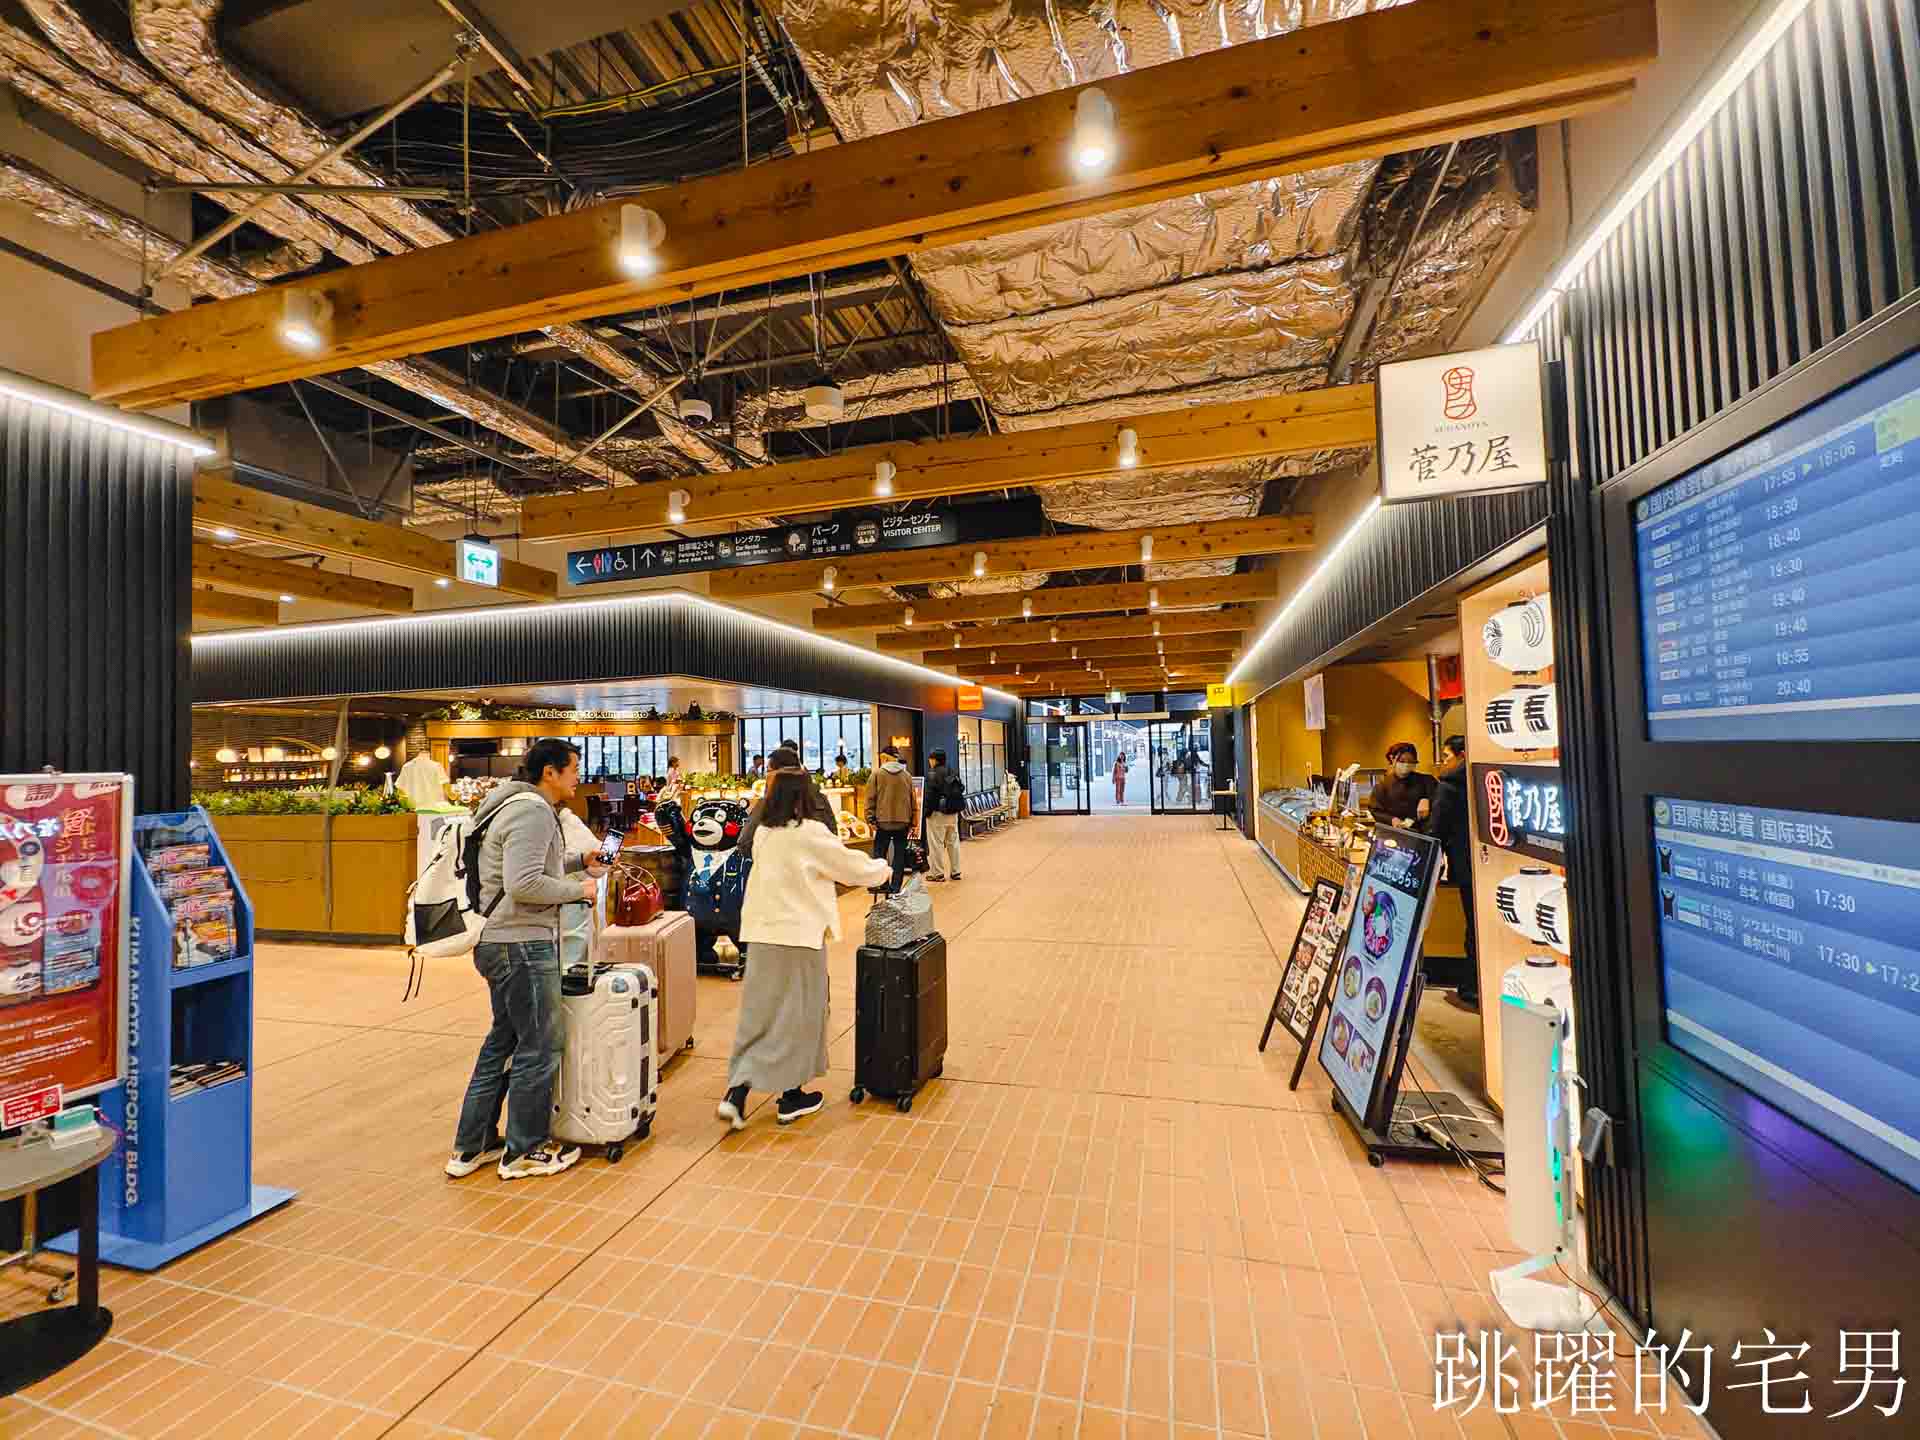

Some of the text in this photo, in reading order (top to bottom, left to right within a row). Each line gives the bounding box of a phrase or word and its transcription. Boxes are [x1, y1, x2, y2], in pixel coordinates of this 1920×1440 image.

[1409, 435, 1519, 483] 菅乃屋
[812, 524, 840, 536] パーク
[882, 513, 940, 528] ビジターセンター
[883, 524, 941, 537] VISITOR CENTER
[735, 535, 768, 544] レンタカー
[1777, 680, 1811, 696] 20:40
[1507, 779, 1564, 834] 菅乃屋
[1672, 804, 1835, 850] 国際線到着 国际到达
[1816, 889, 1856, 913] 17:30
[128, 917, 141, 1047] KUMAMOTO
[1818, 945, 1920, 993] 17:30 17:2
[126, 1055, 140, 1145] AIRPORT
